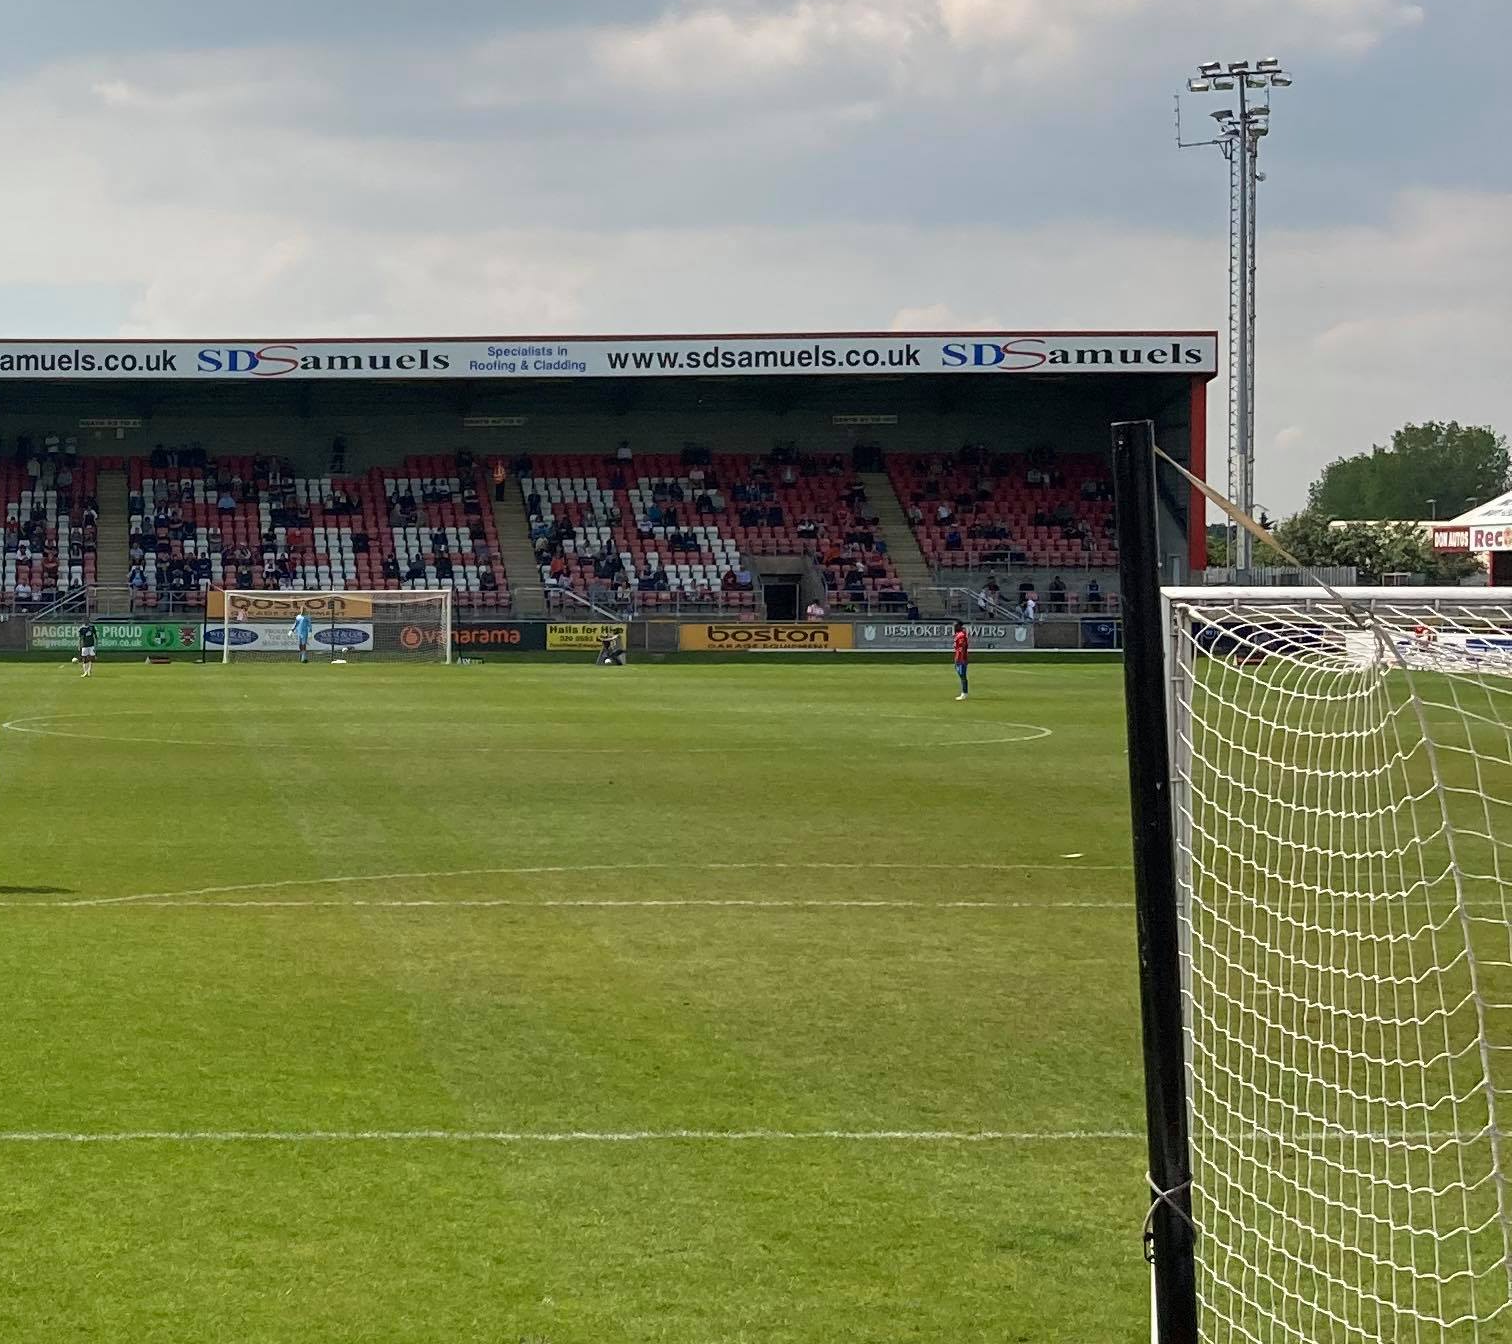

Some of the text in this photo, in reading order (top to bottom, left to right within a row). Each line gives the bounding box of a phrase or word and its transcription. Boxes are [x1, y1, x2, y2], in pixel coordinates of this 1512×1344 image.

[487, 345, 568, 358] Specialists in
[606, 344, 921, 370] www.sdsamuels.co.uk
[469, 359, 587, 374] Roofing & Cladding
[102, 625, 143, 638] PROUD
[581, 625, 597, 634] for
[707, 625, 829, 642] boston
[884, 625, 941, 638] BESPOKE
